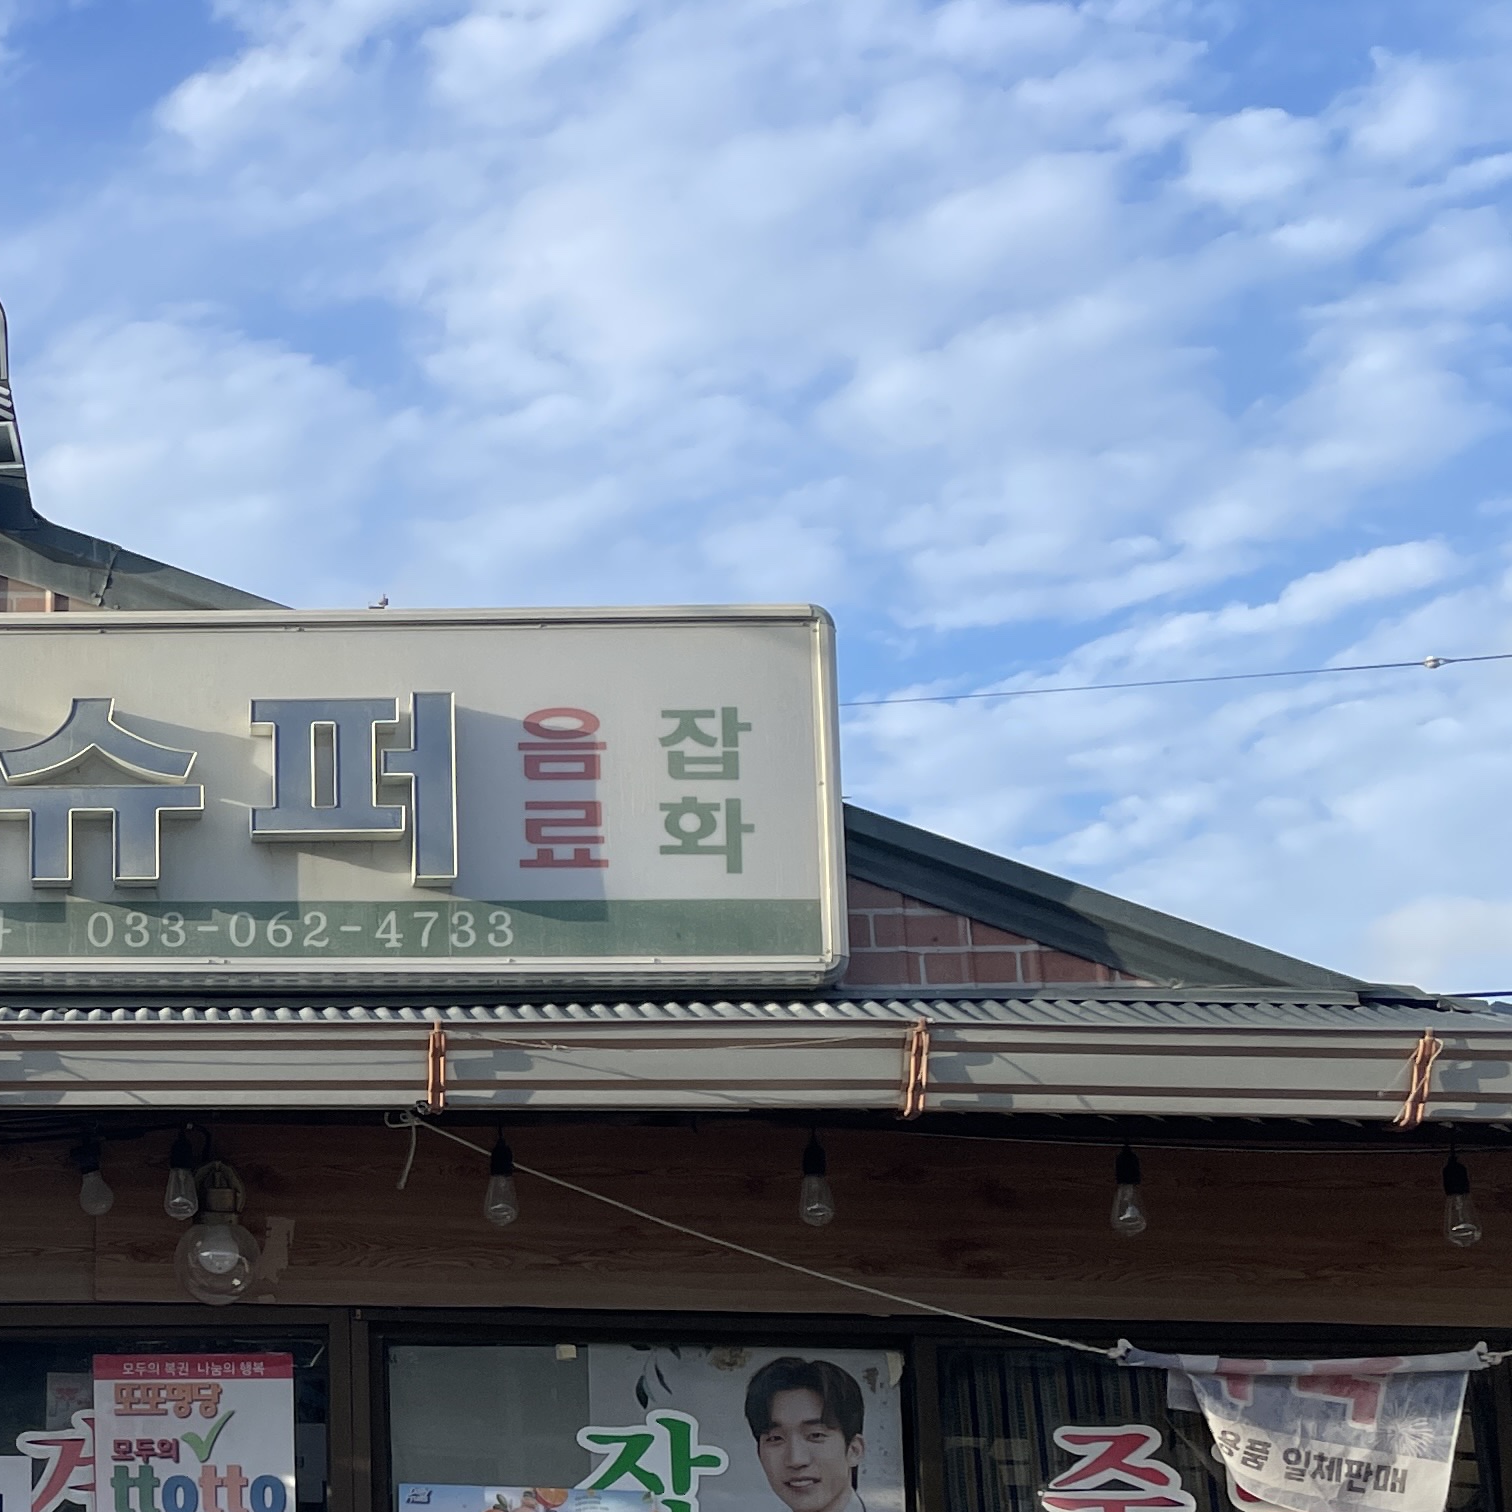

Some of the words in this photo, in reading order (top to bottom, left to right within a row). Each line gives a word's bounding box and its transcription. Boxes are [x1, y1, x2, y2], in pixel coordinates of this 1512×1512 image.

[517, 706, 609, 869] 음료
[659, 706, 755, 875] 잡화
[88, 911, 514, 948] 033-062-4733
[122, 1362, 160, 1376] 모두의
[164, 1362, 189, 1376] 복권
[197, 1362, 236, 1376] 나눔의
[240, 1361, 265, 1377] 행복
[114, 1382, 224, 1419] 또또명당
[111, 1438, 180, 1463] 모두의
[1282, 1447, 1409, 1495] 일체판매
